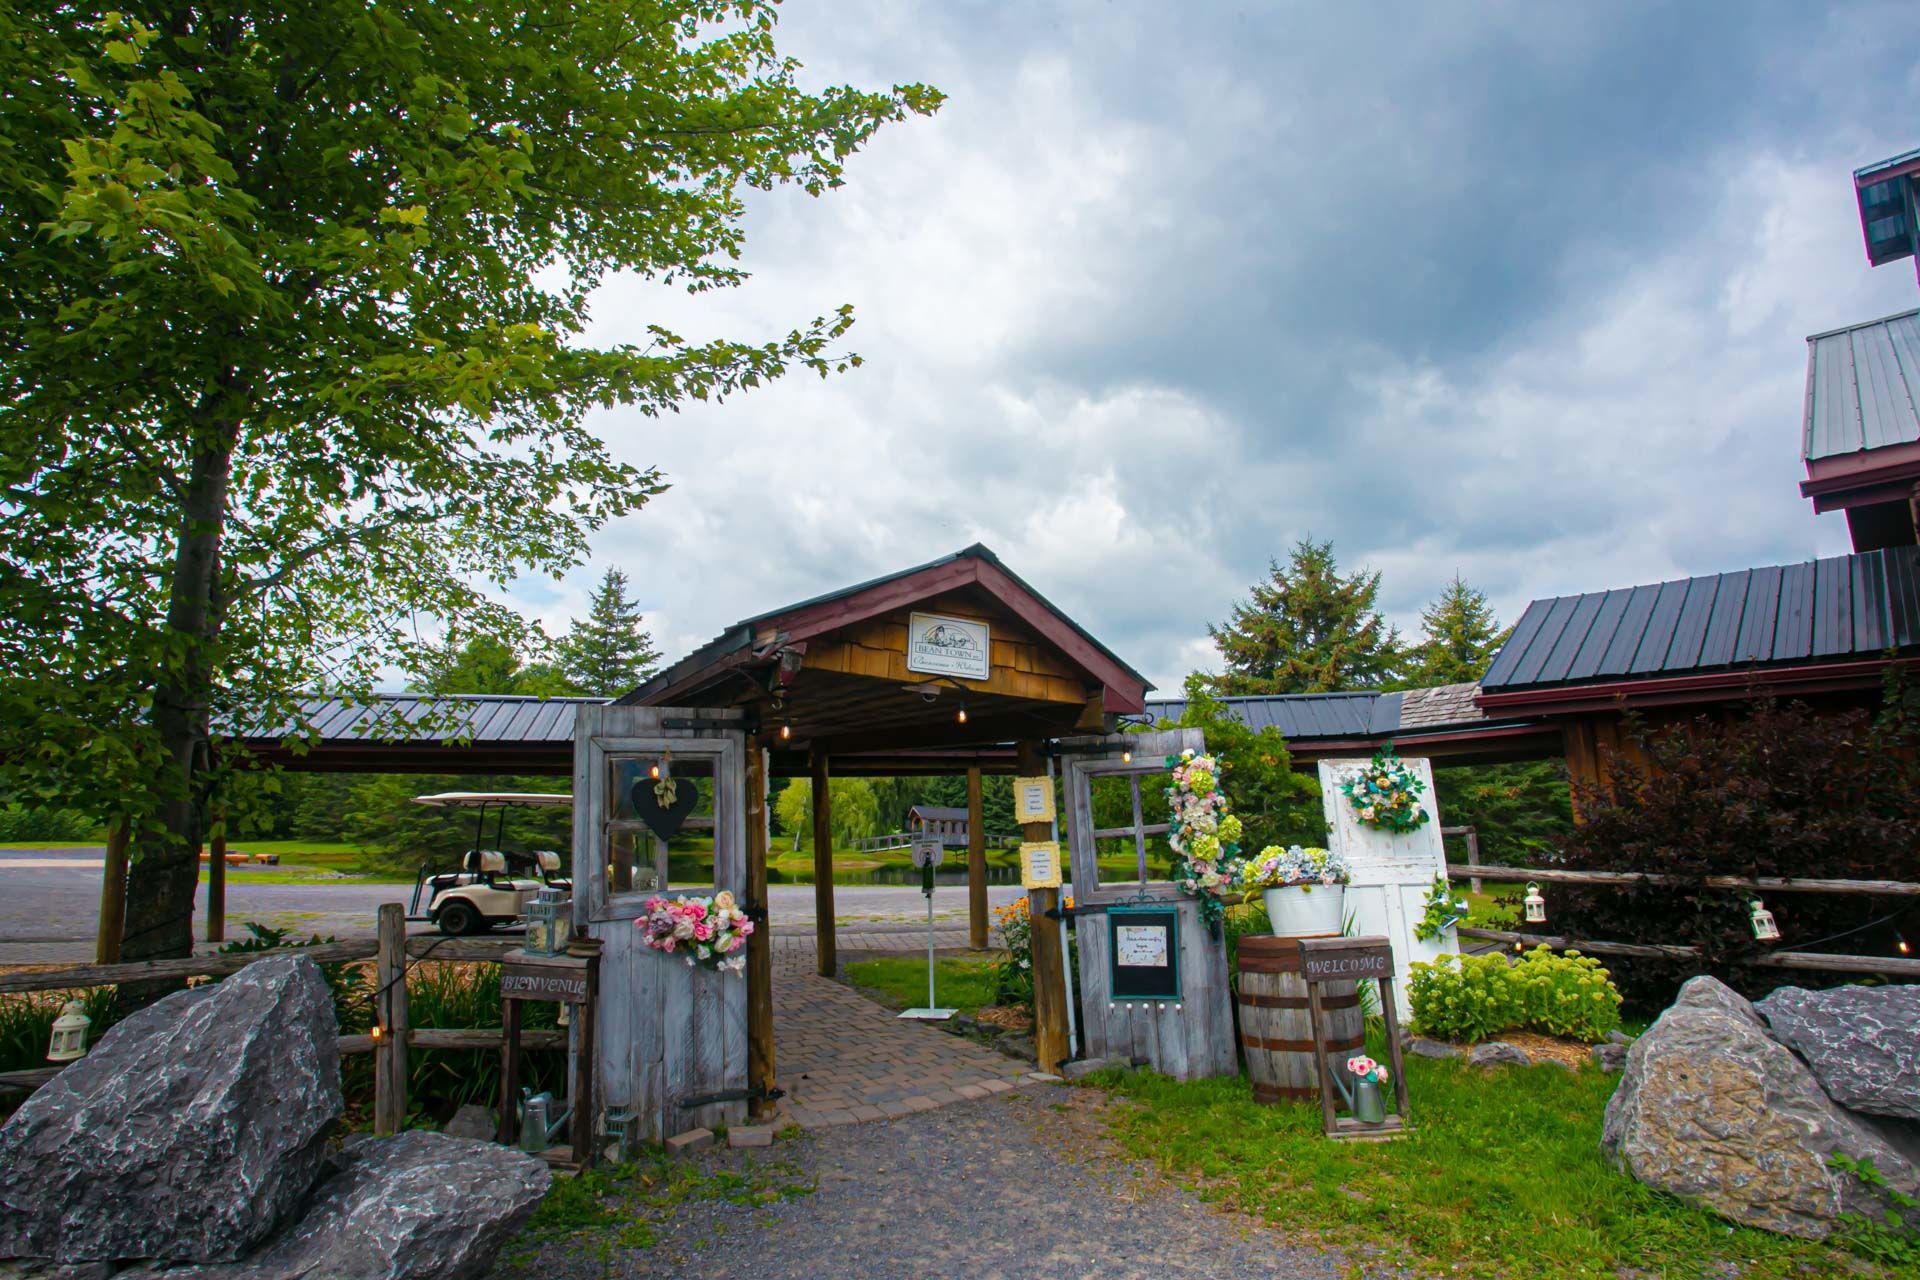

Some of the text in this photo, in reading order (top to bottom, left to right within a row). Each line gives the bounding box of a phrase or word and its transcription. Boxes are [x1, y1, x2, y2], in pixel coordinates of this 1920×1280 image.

[918, 644, 972, 658] BEAN TOWN
[1306, 956, 1385, 974] WELCOME
[501, 975, 587, 994] BIENVENUE
